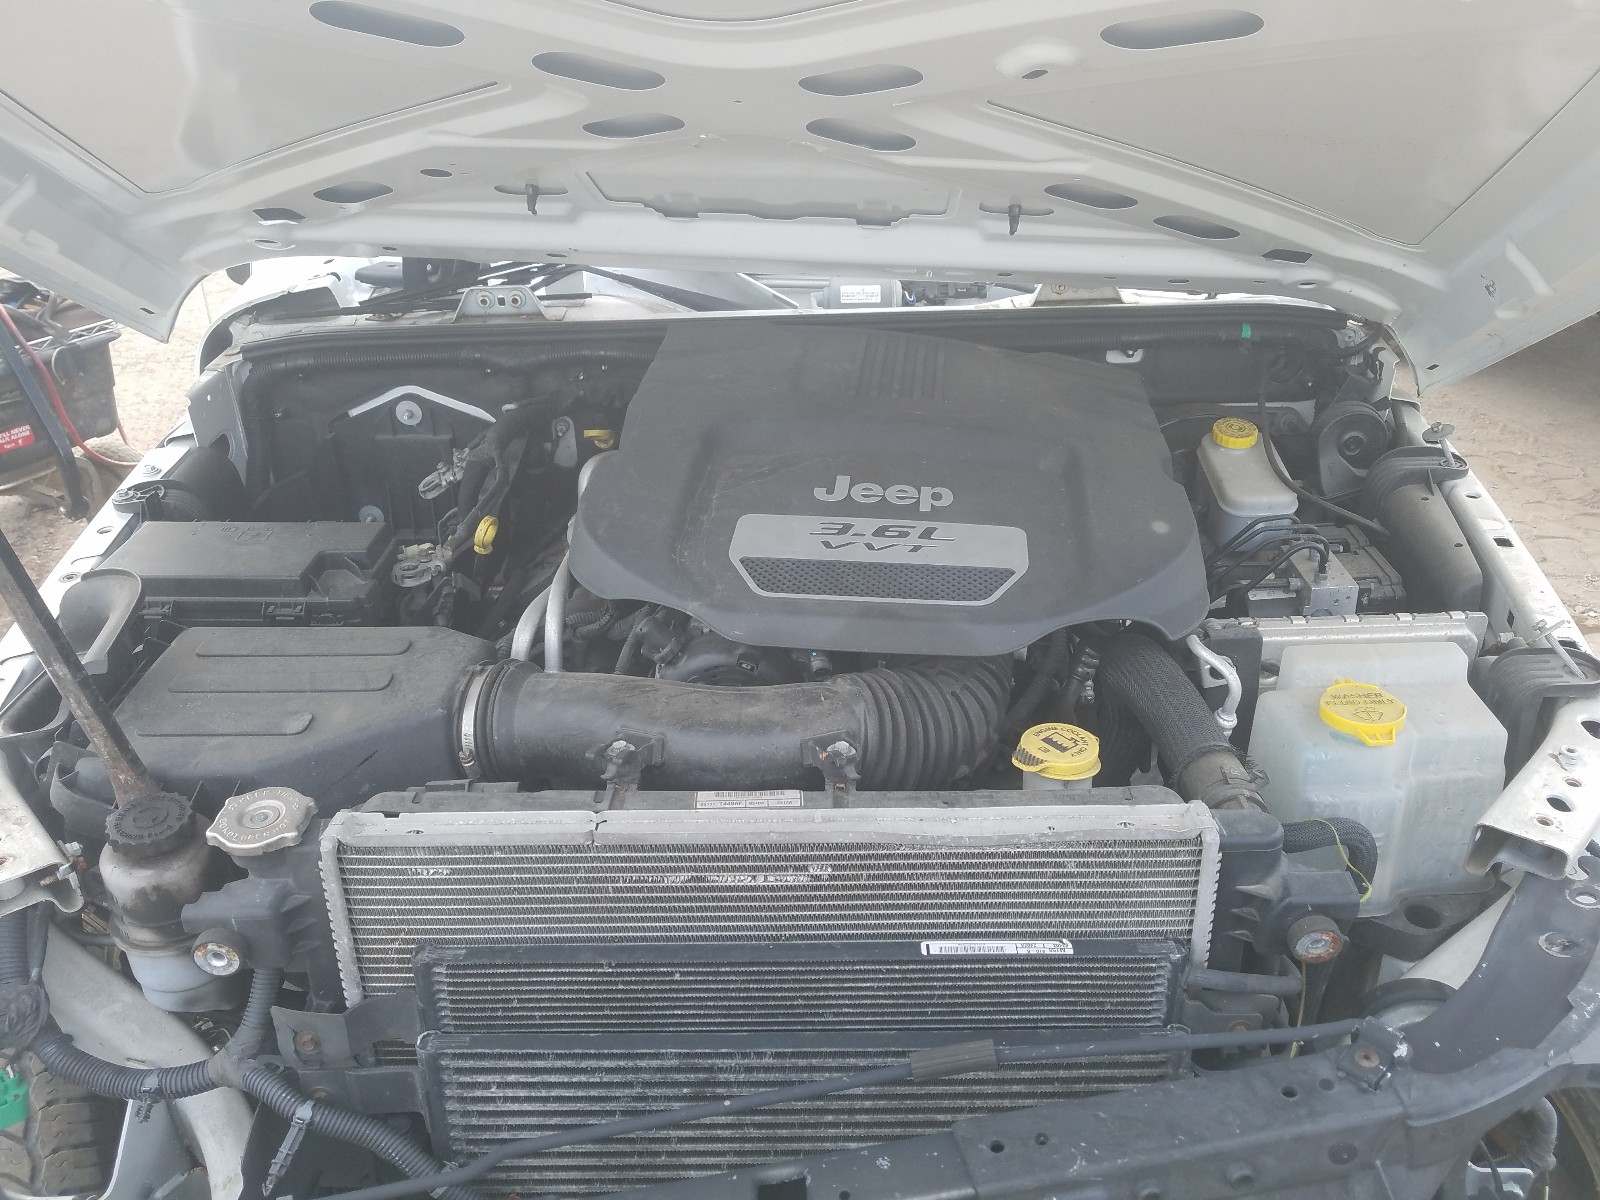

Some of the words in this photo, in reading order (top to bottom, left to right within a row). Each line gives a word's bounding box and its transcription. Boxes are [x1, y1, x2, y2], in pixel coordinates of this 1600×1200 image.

[813, 475, 954, 512] Jeep
[809, 521, 956, 541] 3.6L
[820, 539, 938, 553] VVT
[1330, 692, 1384, 700] WASHER
[1032, 726, 1059, 738] ENGINE
[1060, 726, 1089, 747] COOLANT
[1070, 747, 1088, 758] ONLY
